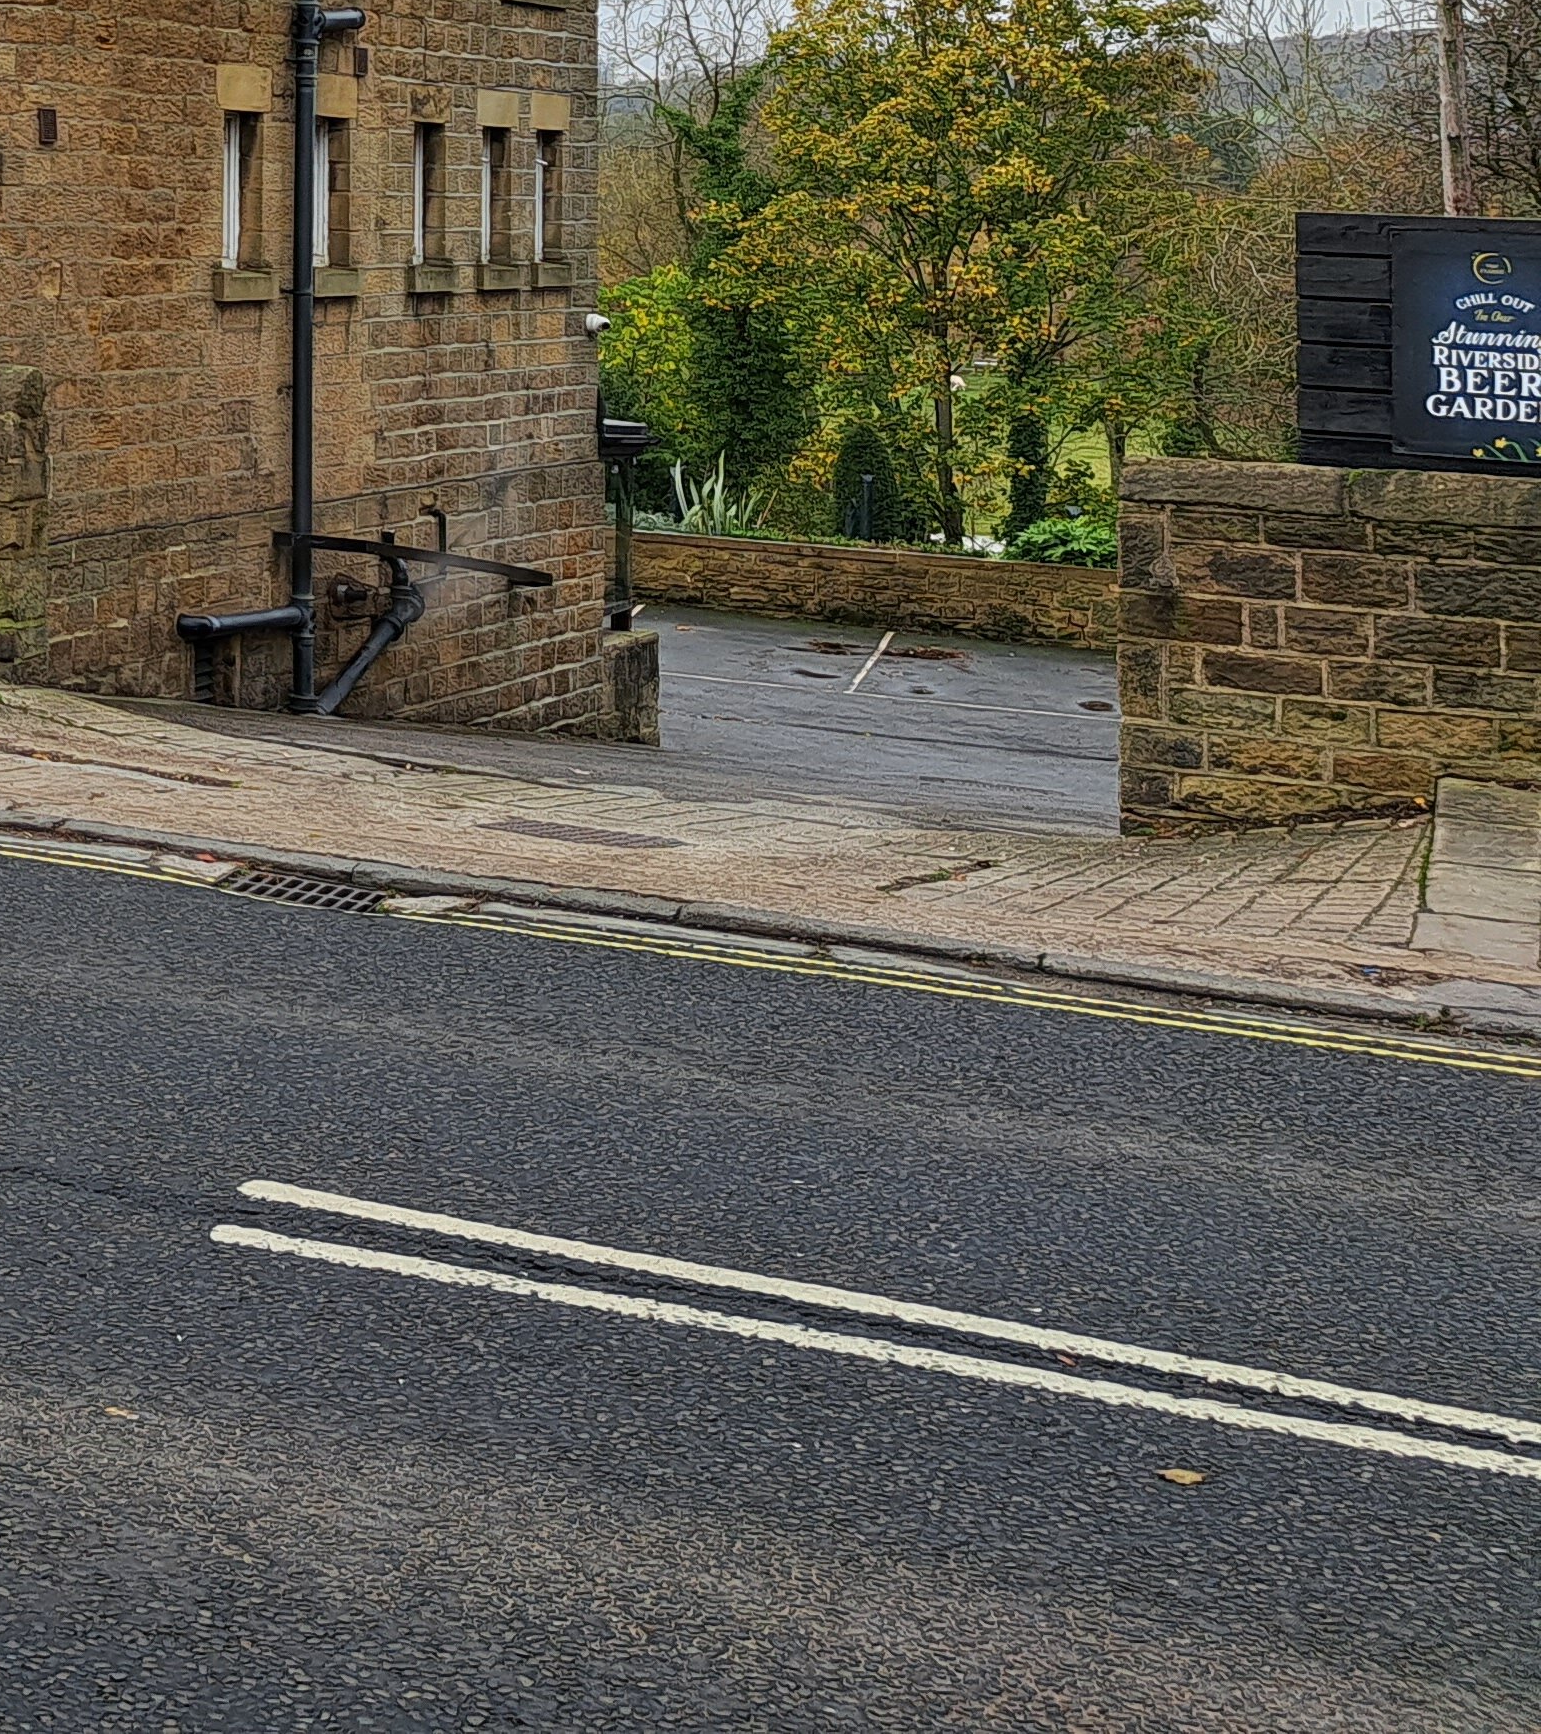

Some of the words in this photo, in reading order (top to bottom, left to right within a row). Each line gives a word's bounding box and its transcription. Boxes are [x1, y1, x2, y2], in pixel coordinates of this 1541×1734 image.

[1456, 292, 1497, 310] CHILL
[1501, 294, 1535, 313] OUT
[1431, 321, 1541, 353] Stunnin
[1432, 346, 1541, 371] RIVERSID
[1439, 367, 1541, 398] BEER
[1426, 394, 1541, 423] GARDE
